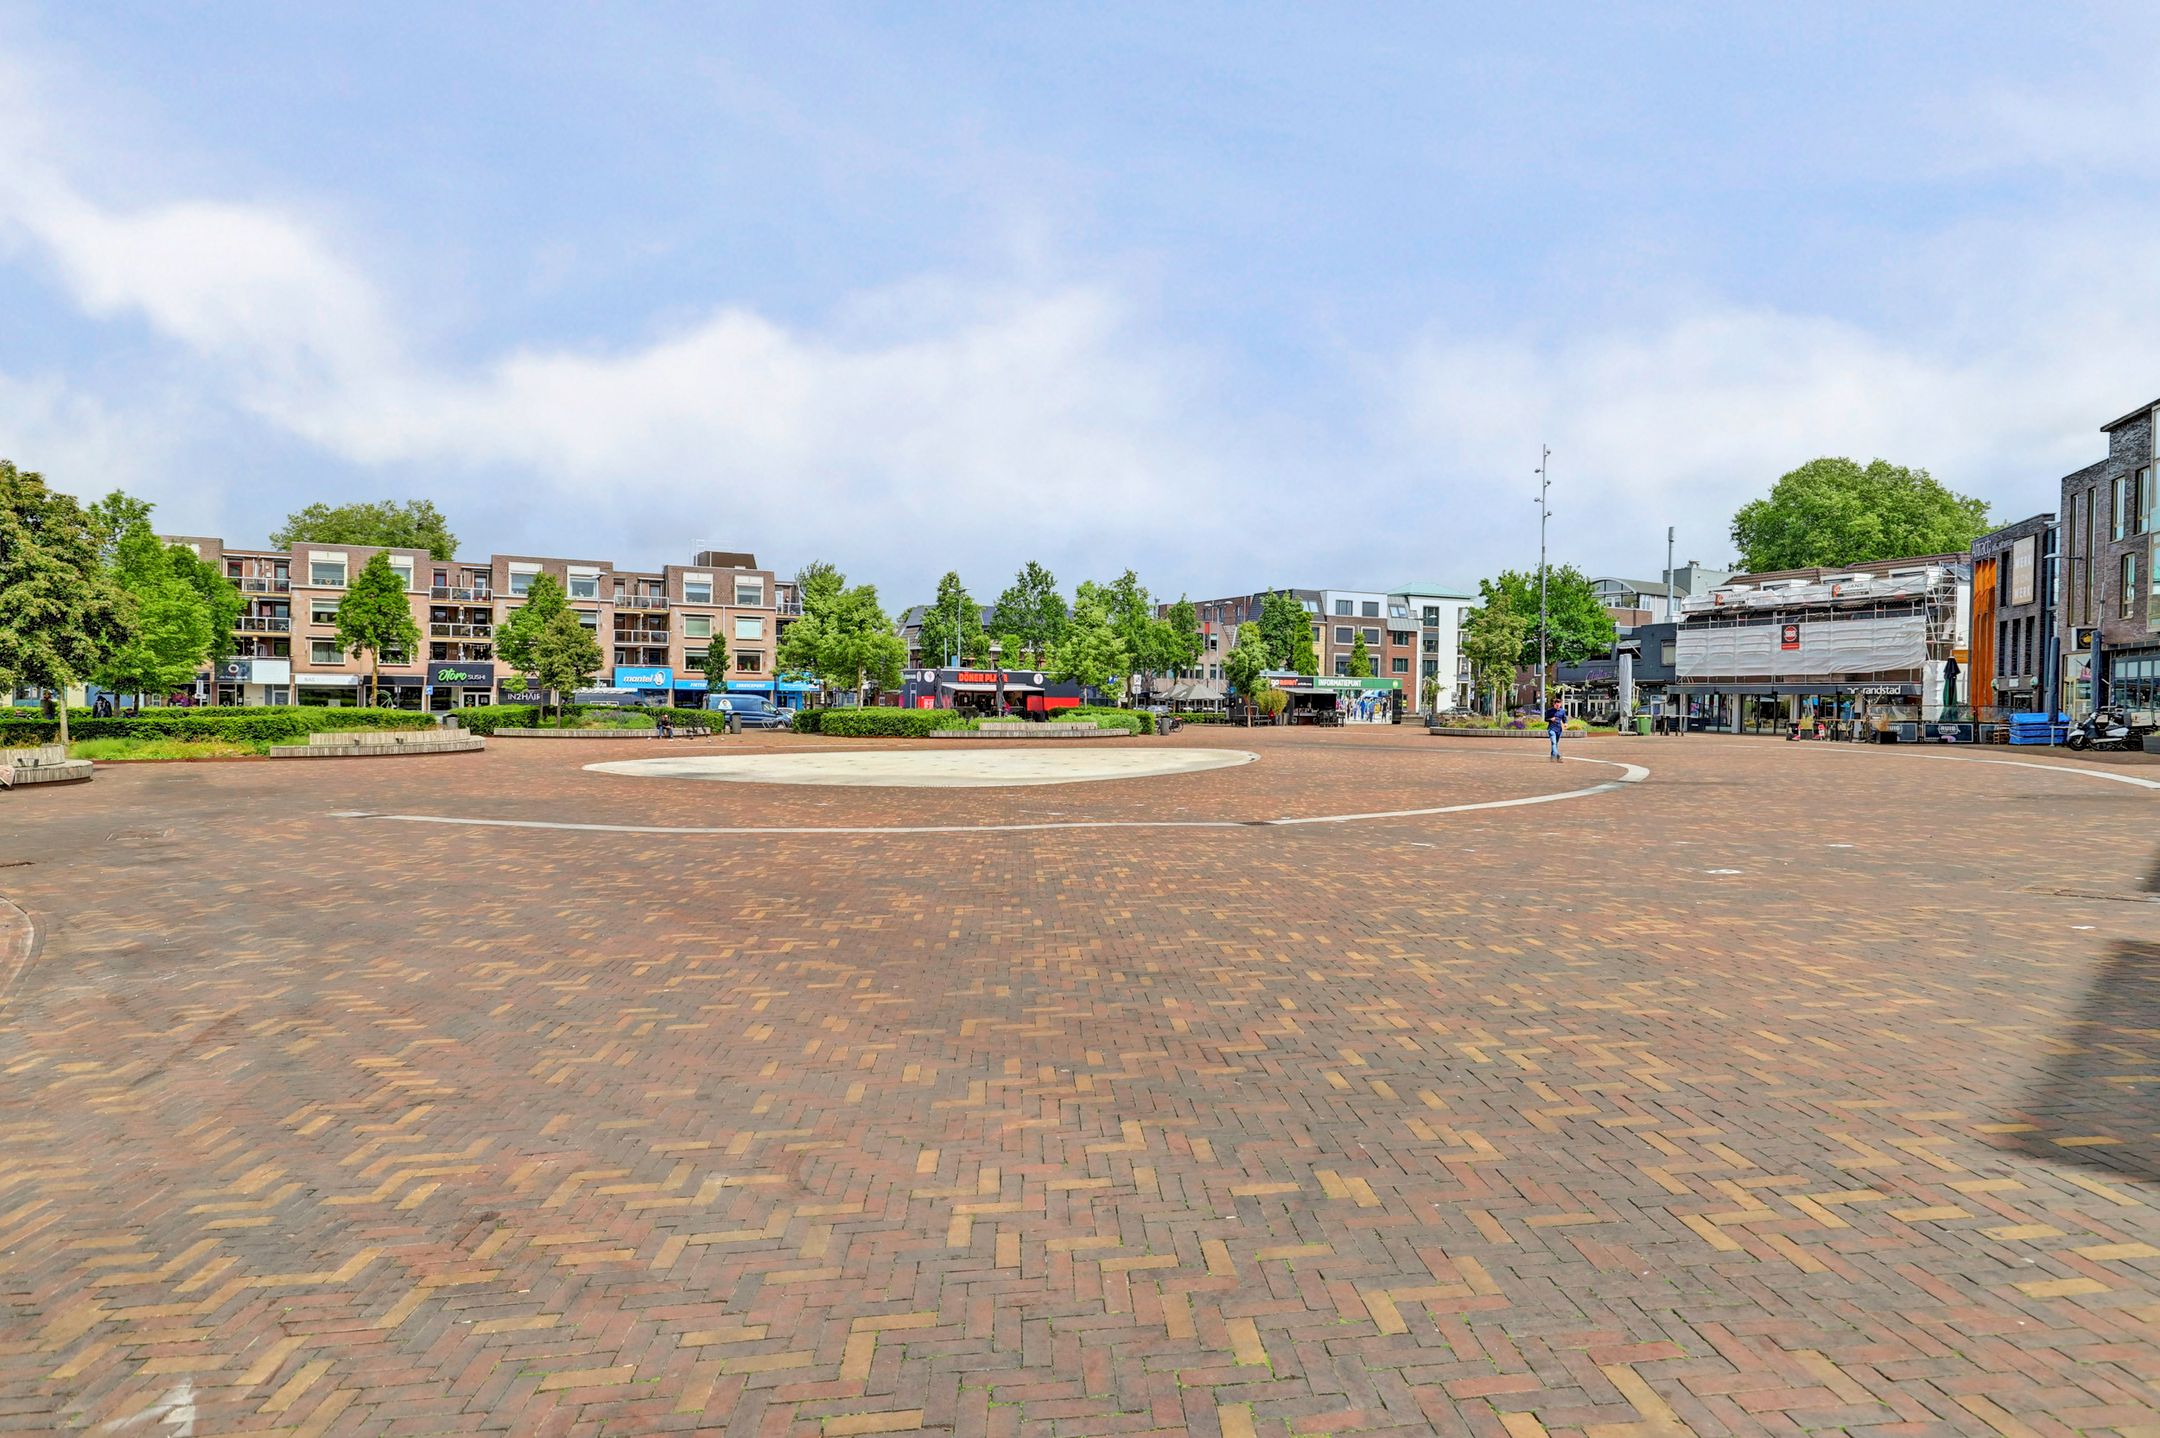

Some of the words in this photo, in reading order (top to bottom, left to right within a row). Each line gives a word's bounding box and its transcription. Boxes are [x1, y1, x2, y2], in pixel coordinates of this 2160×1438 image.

[438, 668, 467, 681] Otoro
[623, 674, 654, 682] mantel
[958, 672, 984, 682] DÖNER
[985, 673, 1008, 682] PLAA
[1862, 685, 1901, 695] randstad
